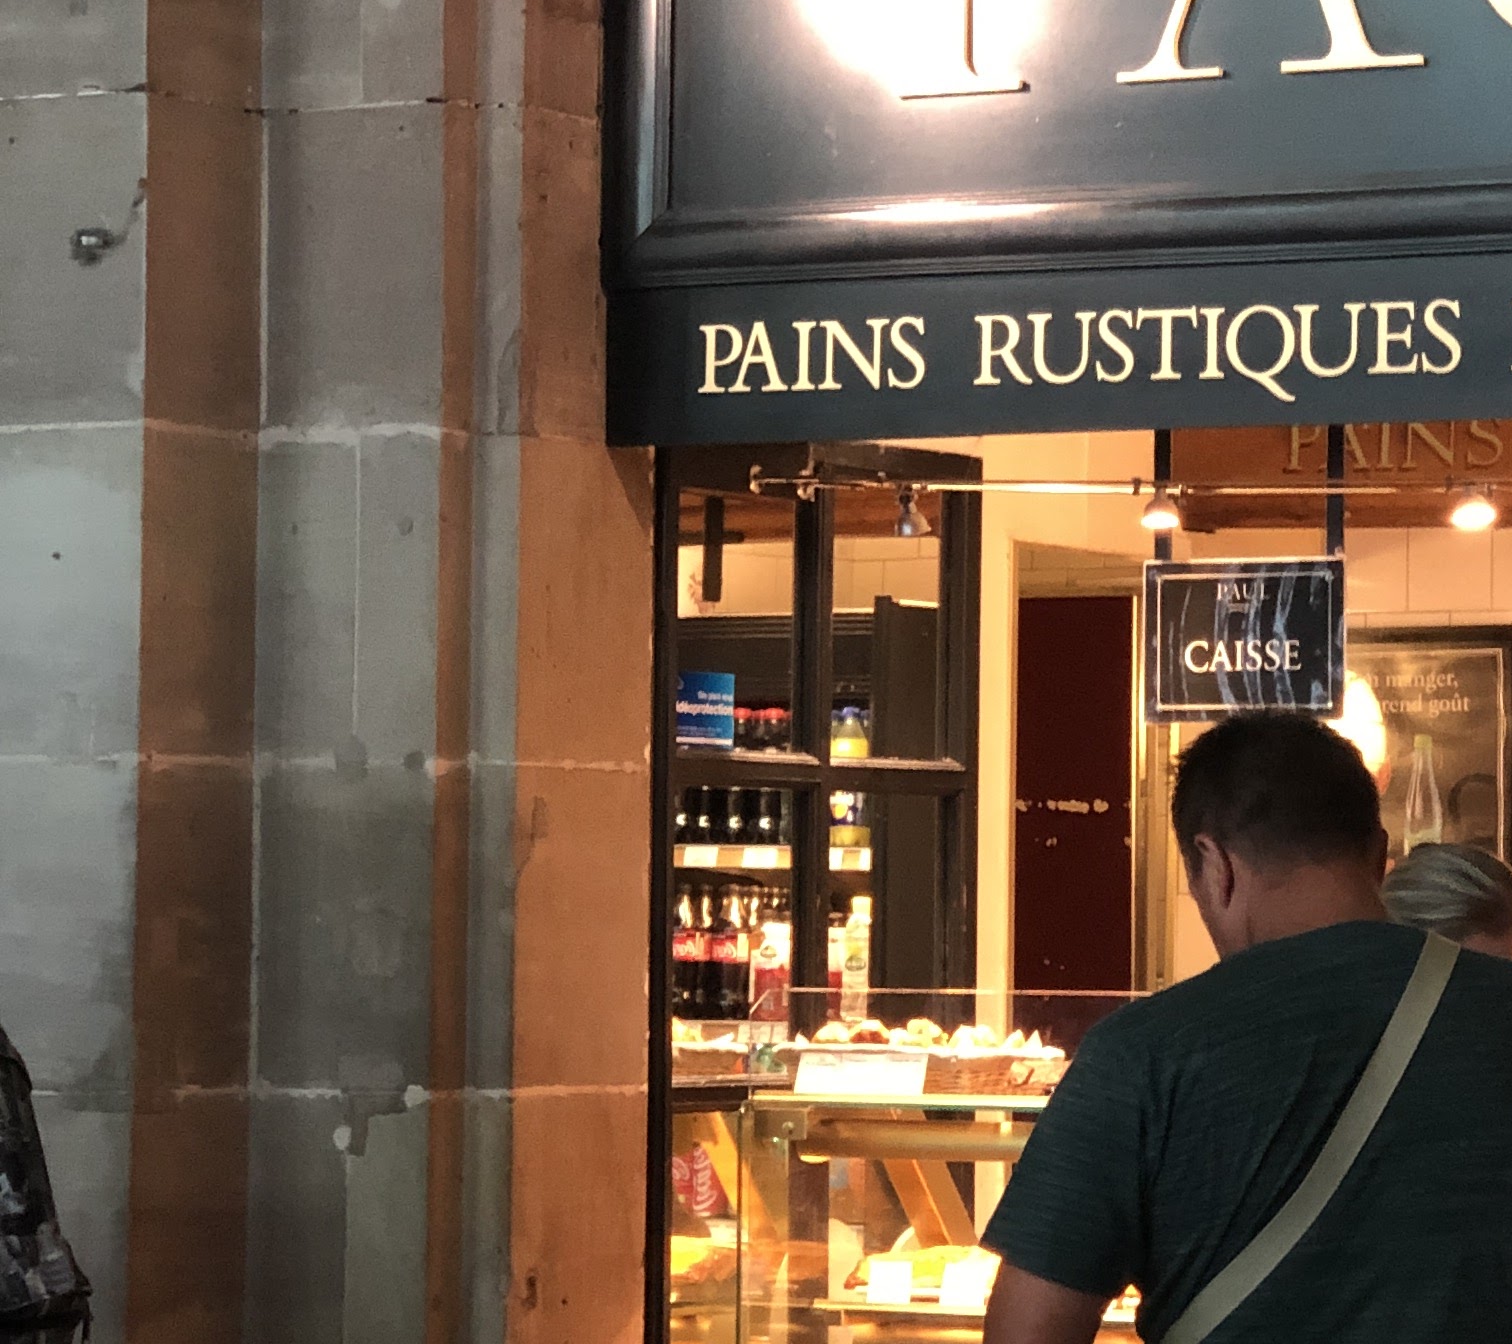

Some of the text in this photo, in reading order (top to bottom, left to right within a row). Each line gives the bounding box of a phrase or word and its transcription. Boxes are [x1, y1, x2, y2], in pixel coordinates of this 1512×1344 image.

[698, 315, 926, 393] PAINS
[974, 299, 1462, 402] RUSTIQUES
[1217, 582, 1270, 601] PAUL
[1184, 639, 1302, 674] CAISSE
[1382, 691, 1471, 718] rend goût
